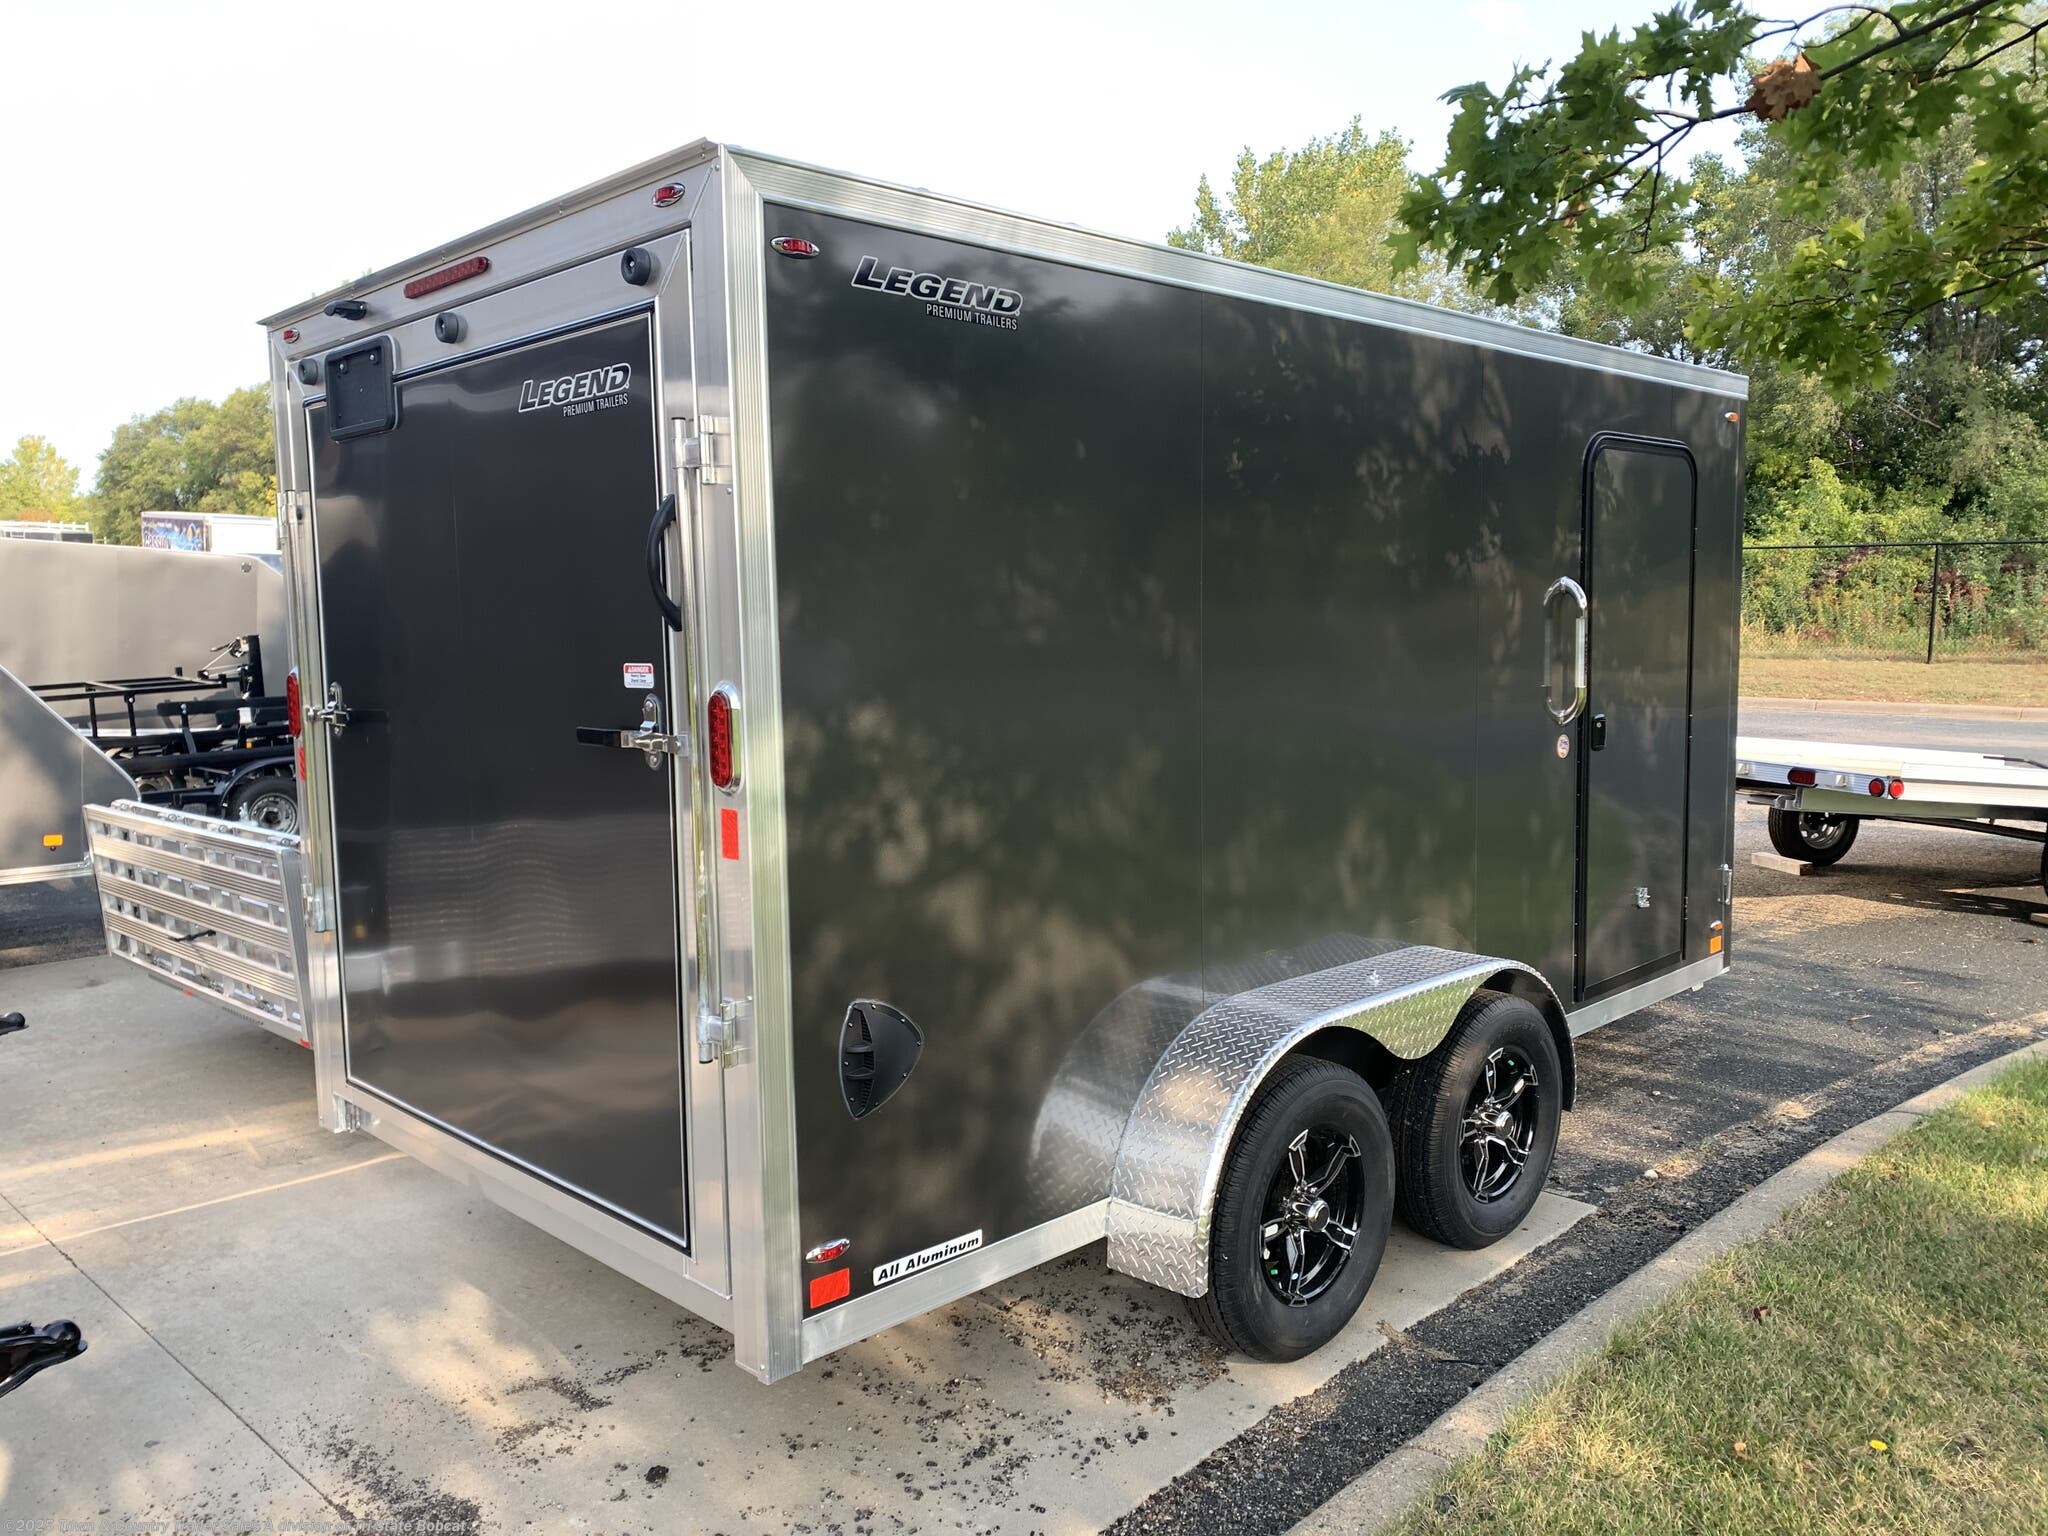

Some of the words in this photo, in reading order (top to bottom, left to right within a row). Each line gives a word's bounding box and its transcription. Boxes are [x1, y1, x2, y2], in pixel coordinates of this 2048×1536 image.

[851, 255, 1023, 316] LEGEND
[926, 303, 972, 322] PREMIUM
[974, 312, 1018, 330] TRAILERS
[518, 362, 631, 413] LEGEND
[562, 400, 595, 417] PREMIUM
[596, 393, 628, 409] TRAILERS
[877, 1263, 900, 1282] All
[905, 1237, 979, 1272] Aluminum
